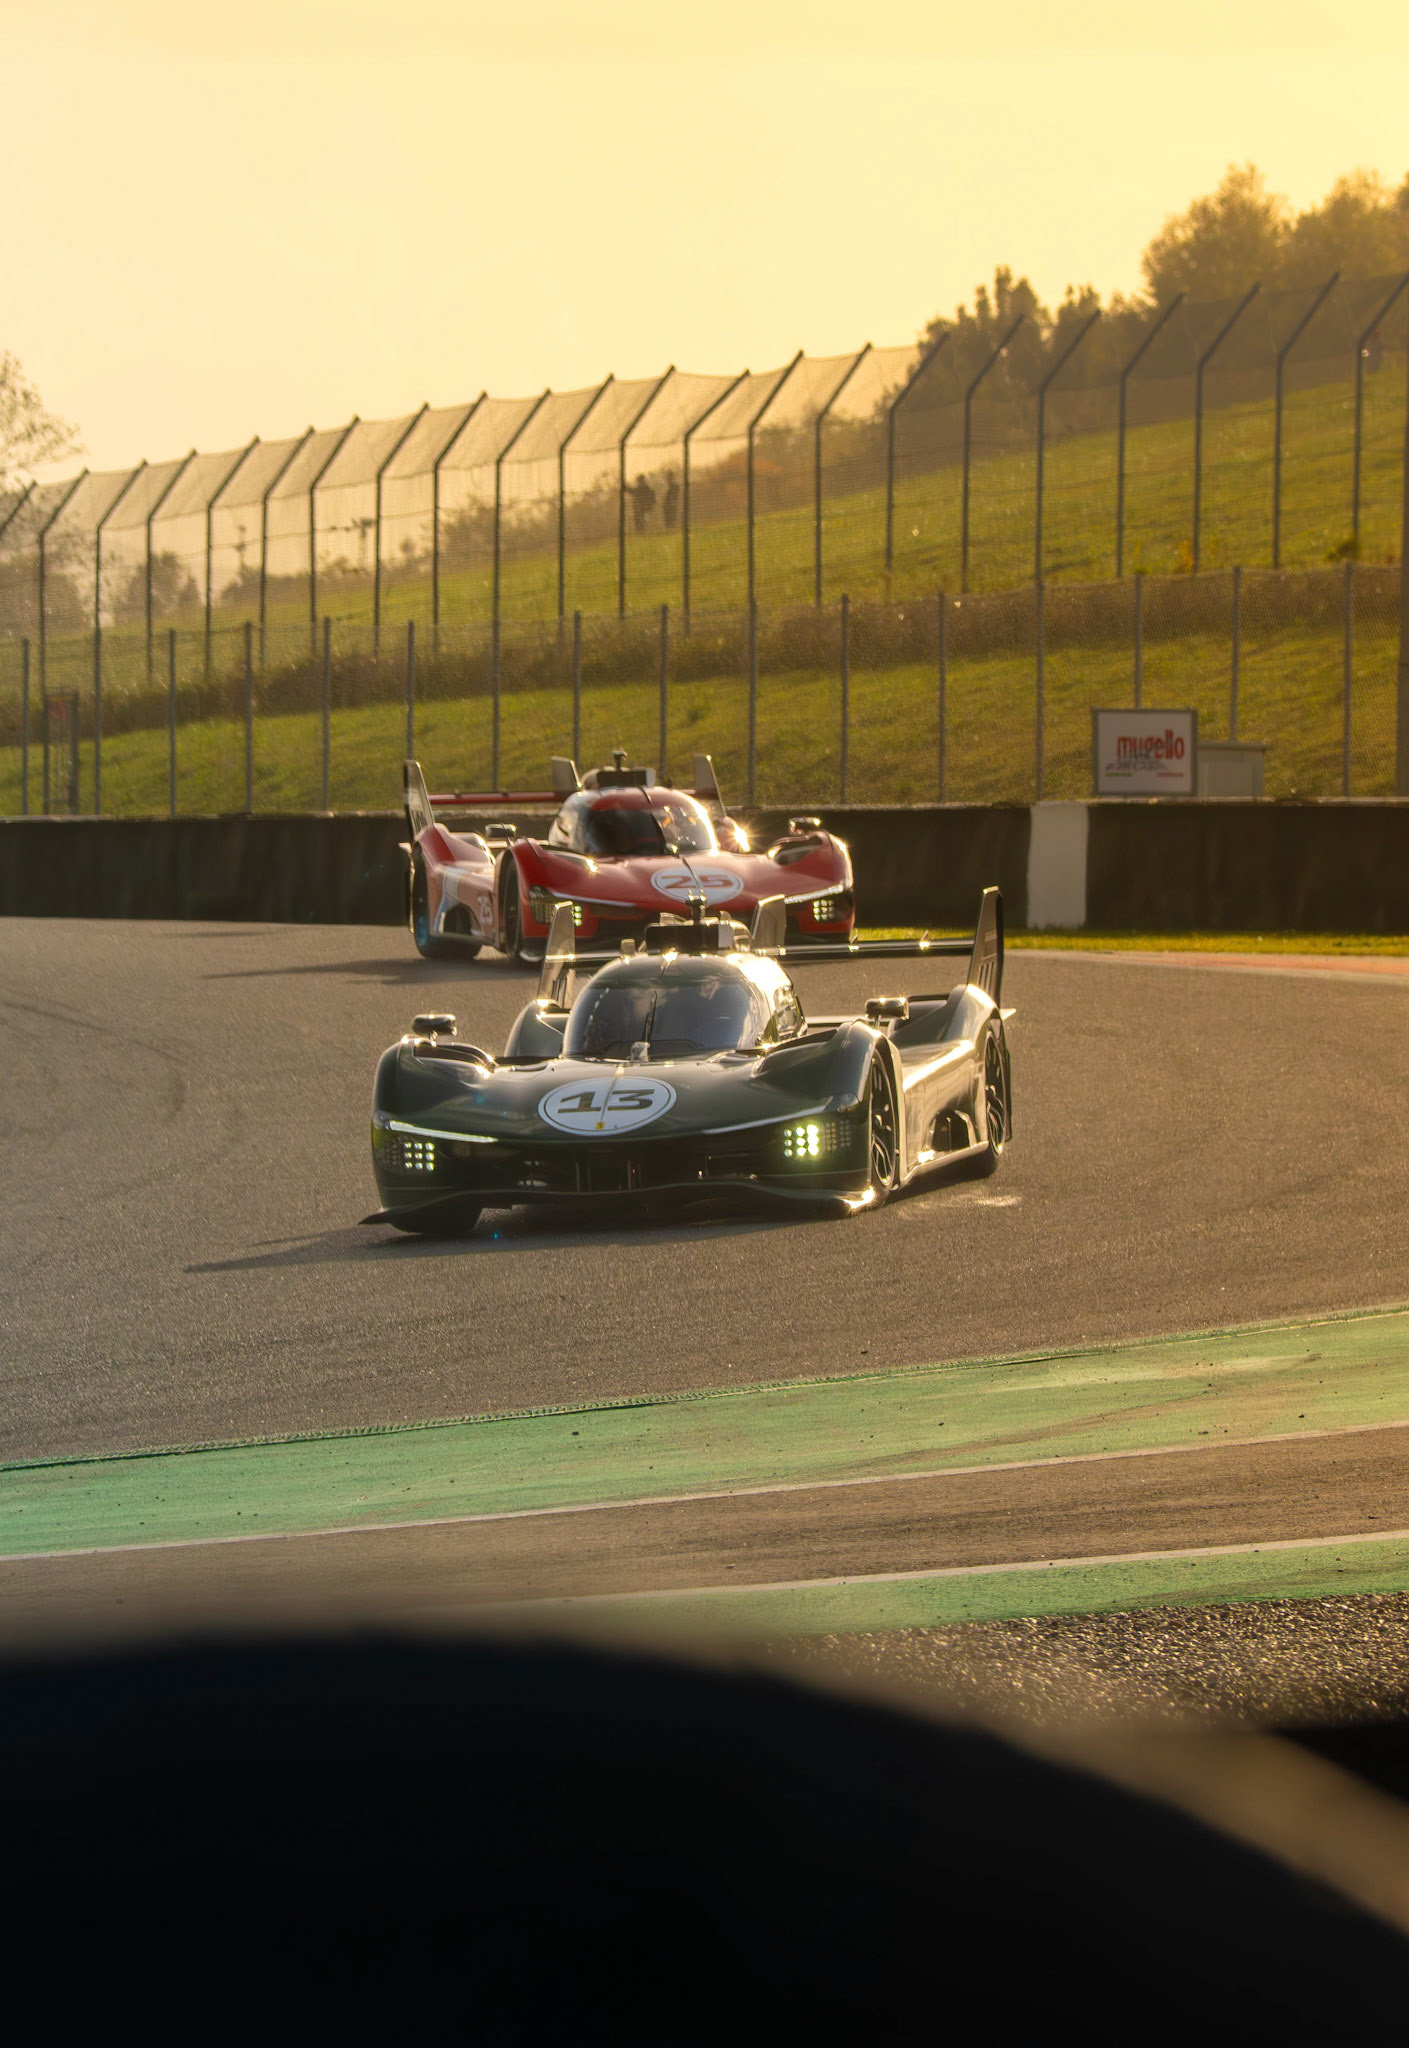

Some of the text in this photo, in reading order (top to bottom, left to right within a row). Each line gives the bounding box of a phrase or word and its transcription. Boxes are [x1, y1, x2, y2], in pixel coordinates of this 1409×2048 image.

[1117, 729, 1185, 760] mugello
[661, 874, 733, 889] 25
[557, 1089, 655, 1113] 13
